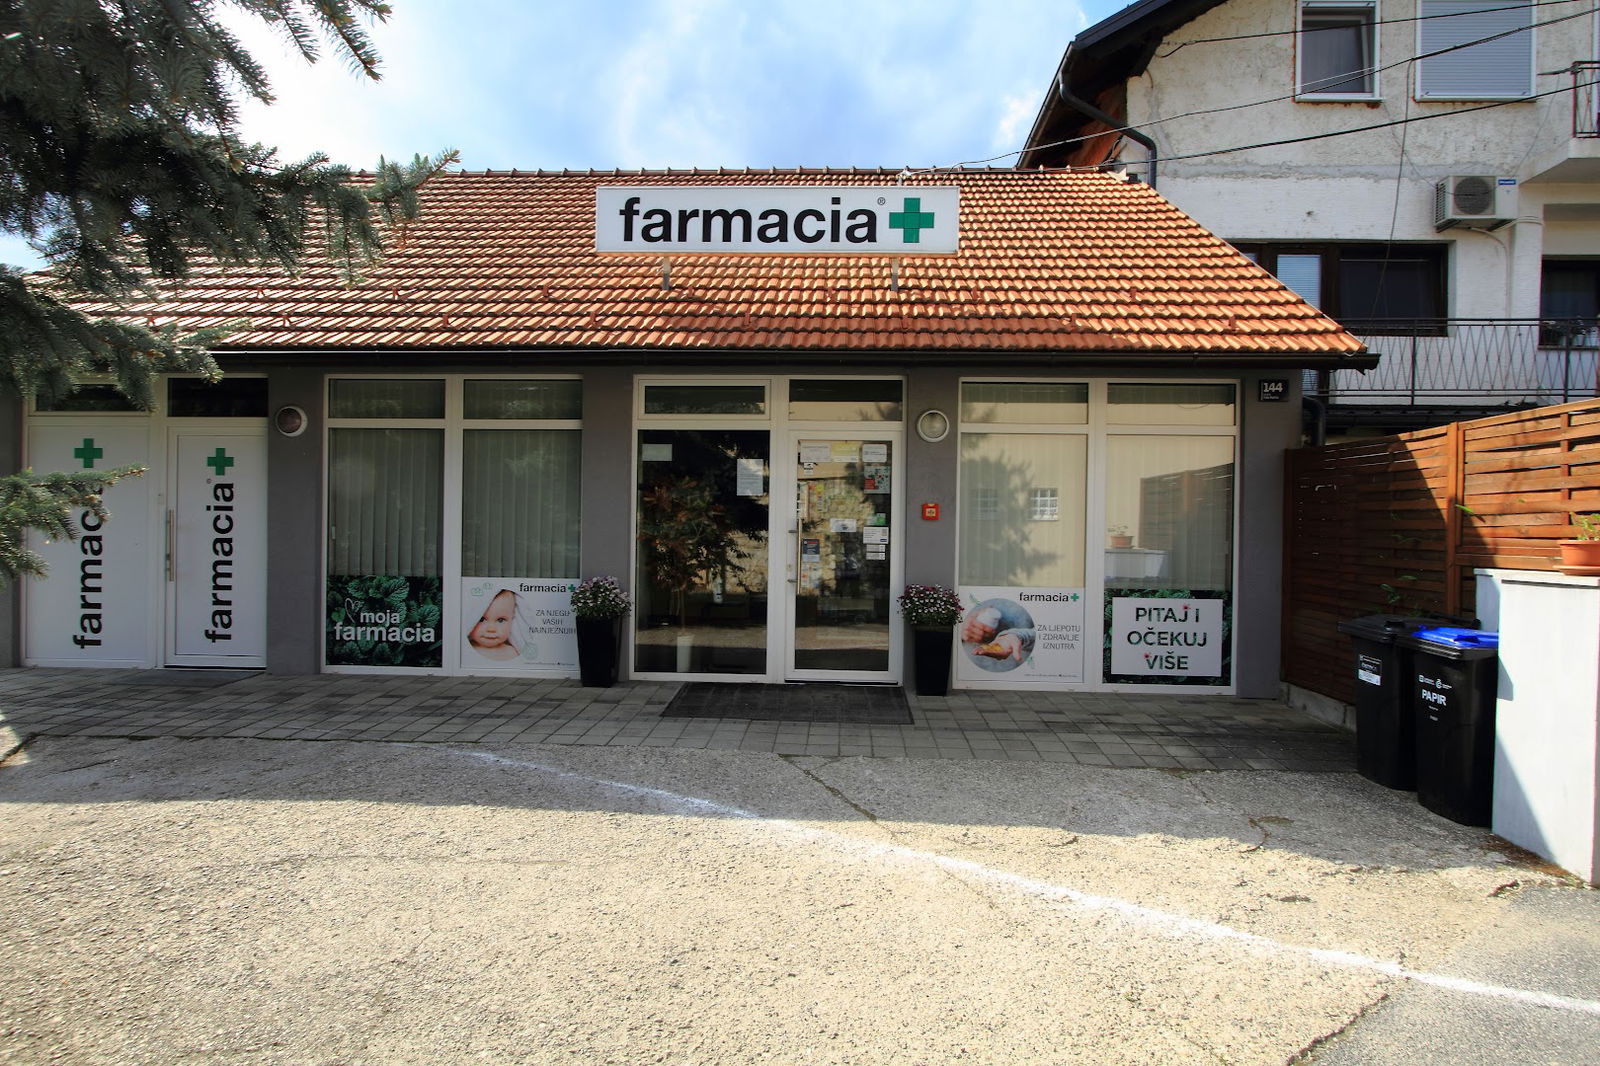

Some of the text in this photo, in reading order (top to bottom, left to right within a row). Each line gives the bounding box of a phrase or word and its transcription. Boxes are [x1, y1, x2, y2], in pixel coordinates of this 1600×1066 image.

[1263, 382, 1283, 393] 144
[73, 487, 103, 649] farmac
[204, 483, 234, 643] farmacia
[519, 583, 567, 593] farmacia
[1019, 592, 1069, 602] farmacia
[360, 610, 400, 627] moja
[535, 609, 545, 617] ZA
[1136, 607, 1200, 623] PITAJ I
[334, 621, 435, 642] farmacia
[1037, 624, 1081, 633] ZA LJEPOTU
[1042, 633, 1080, 642] ZDRAVLJE
[1127, 627, 1207, 647] OČEKUJ
[1042, 642, 1076, 650] IZNUTRA
[1146, 651, 1188, 670] VIŠE
[1421, 689, 1447, 706] PAPIR
